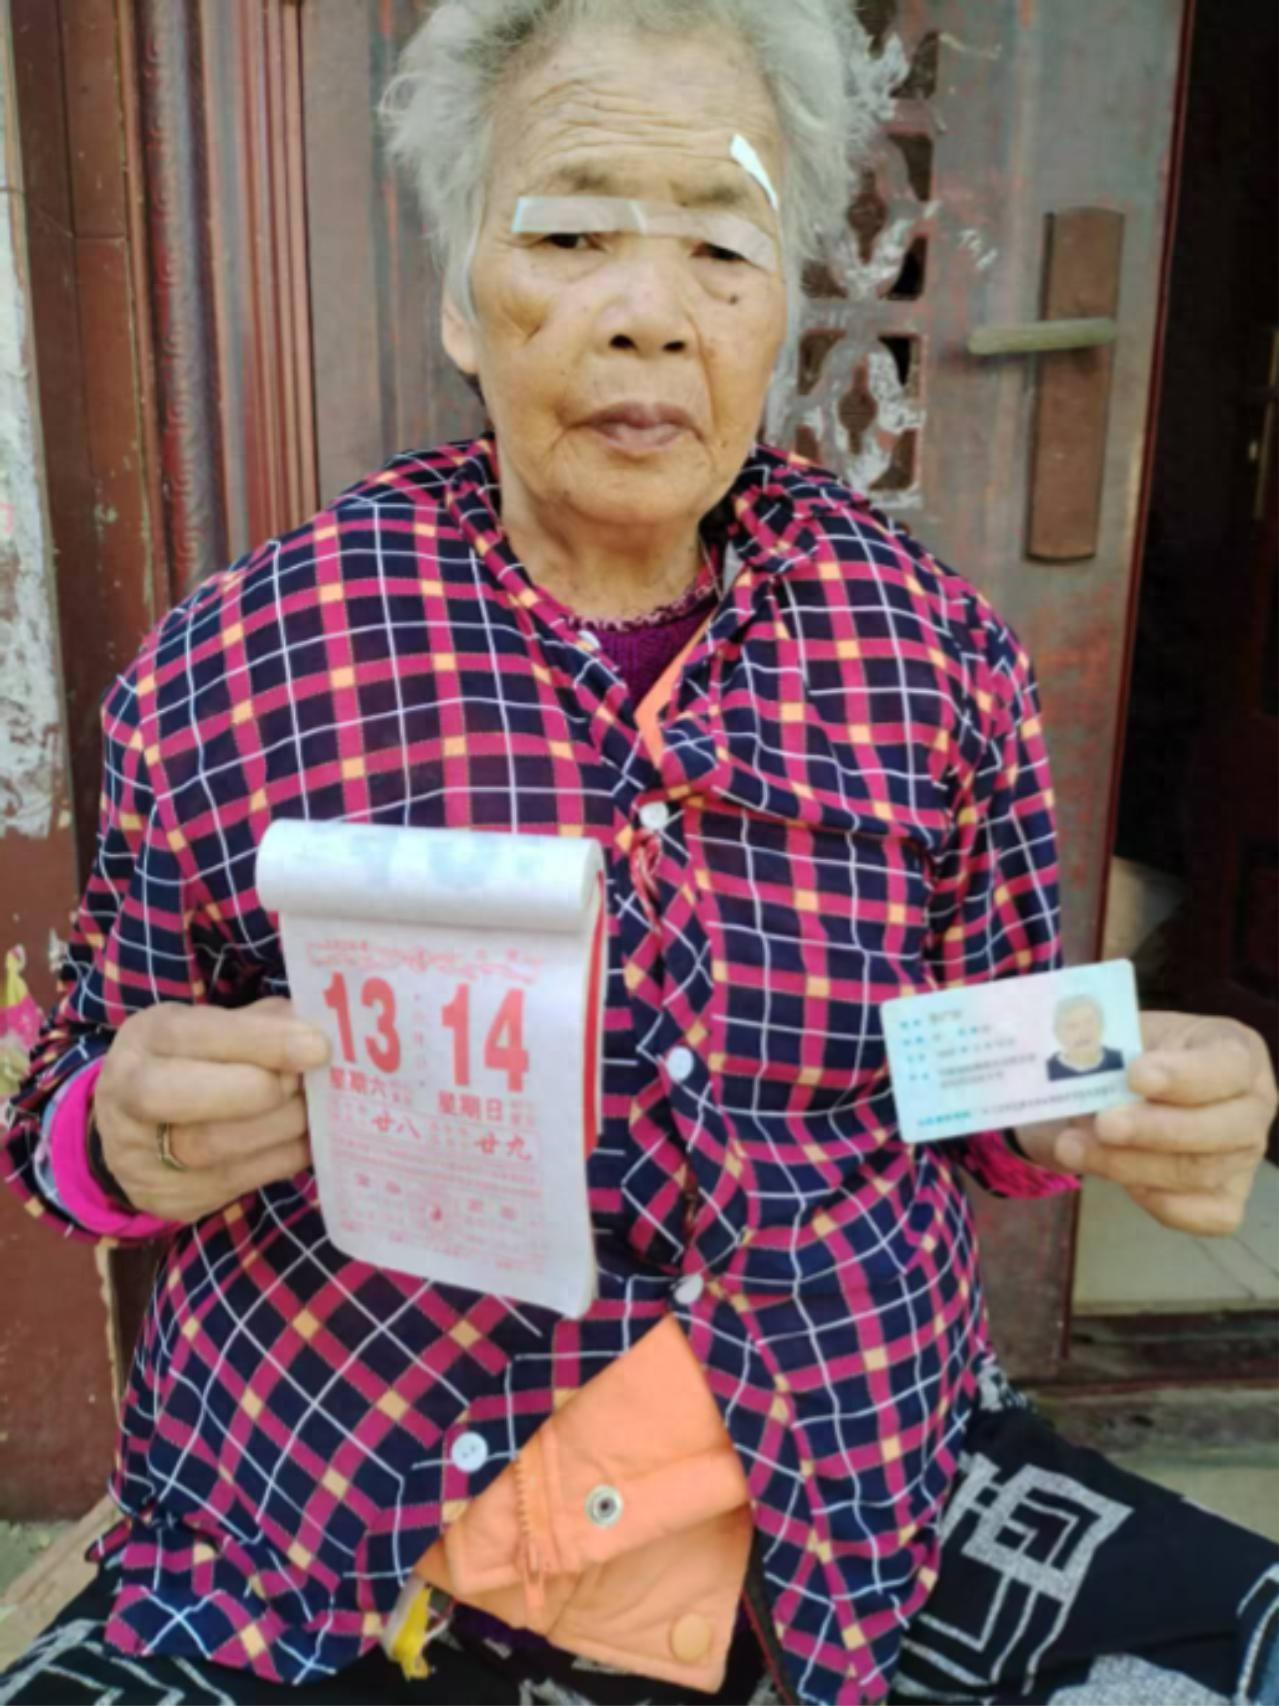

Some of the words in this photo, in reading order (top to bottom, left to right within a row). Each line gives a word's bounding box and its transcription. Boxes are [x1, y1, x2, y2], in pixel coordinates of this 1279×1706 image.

[322, 971, 401, 1074] 13
[441, 983, 529, 1093] 14
[330, 1067, 387, 1097] 星期六
[438, 1090, 503, 1122] 星期日
